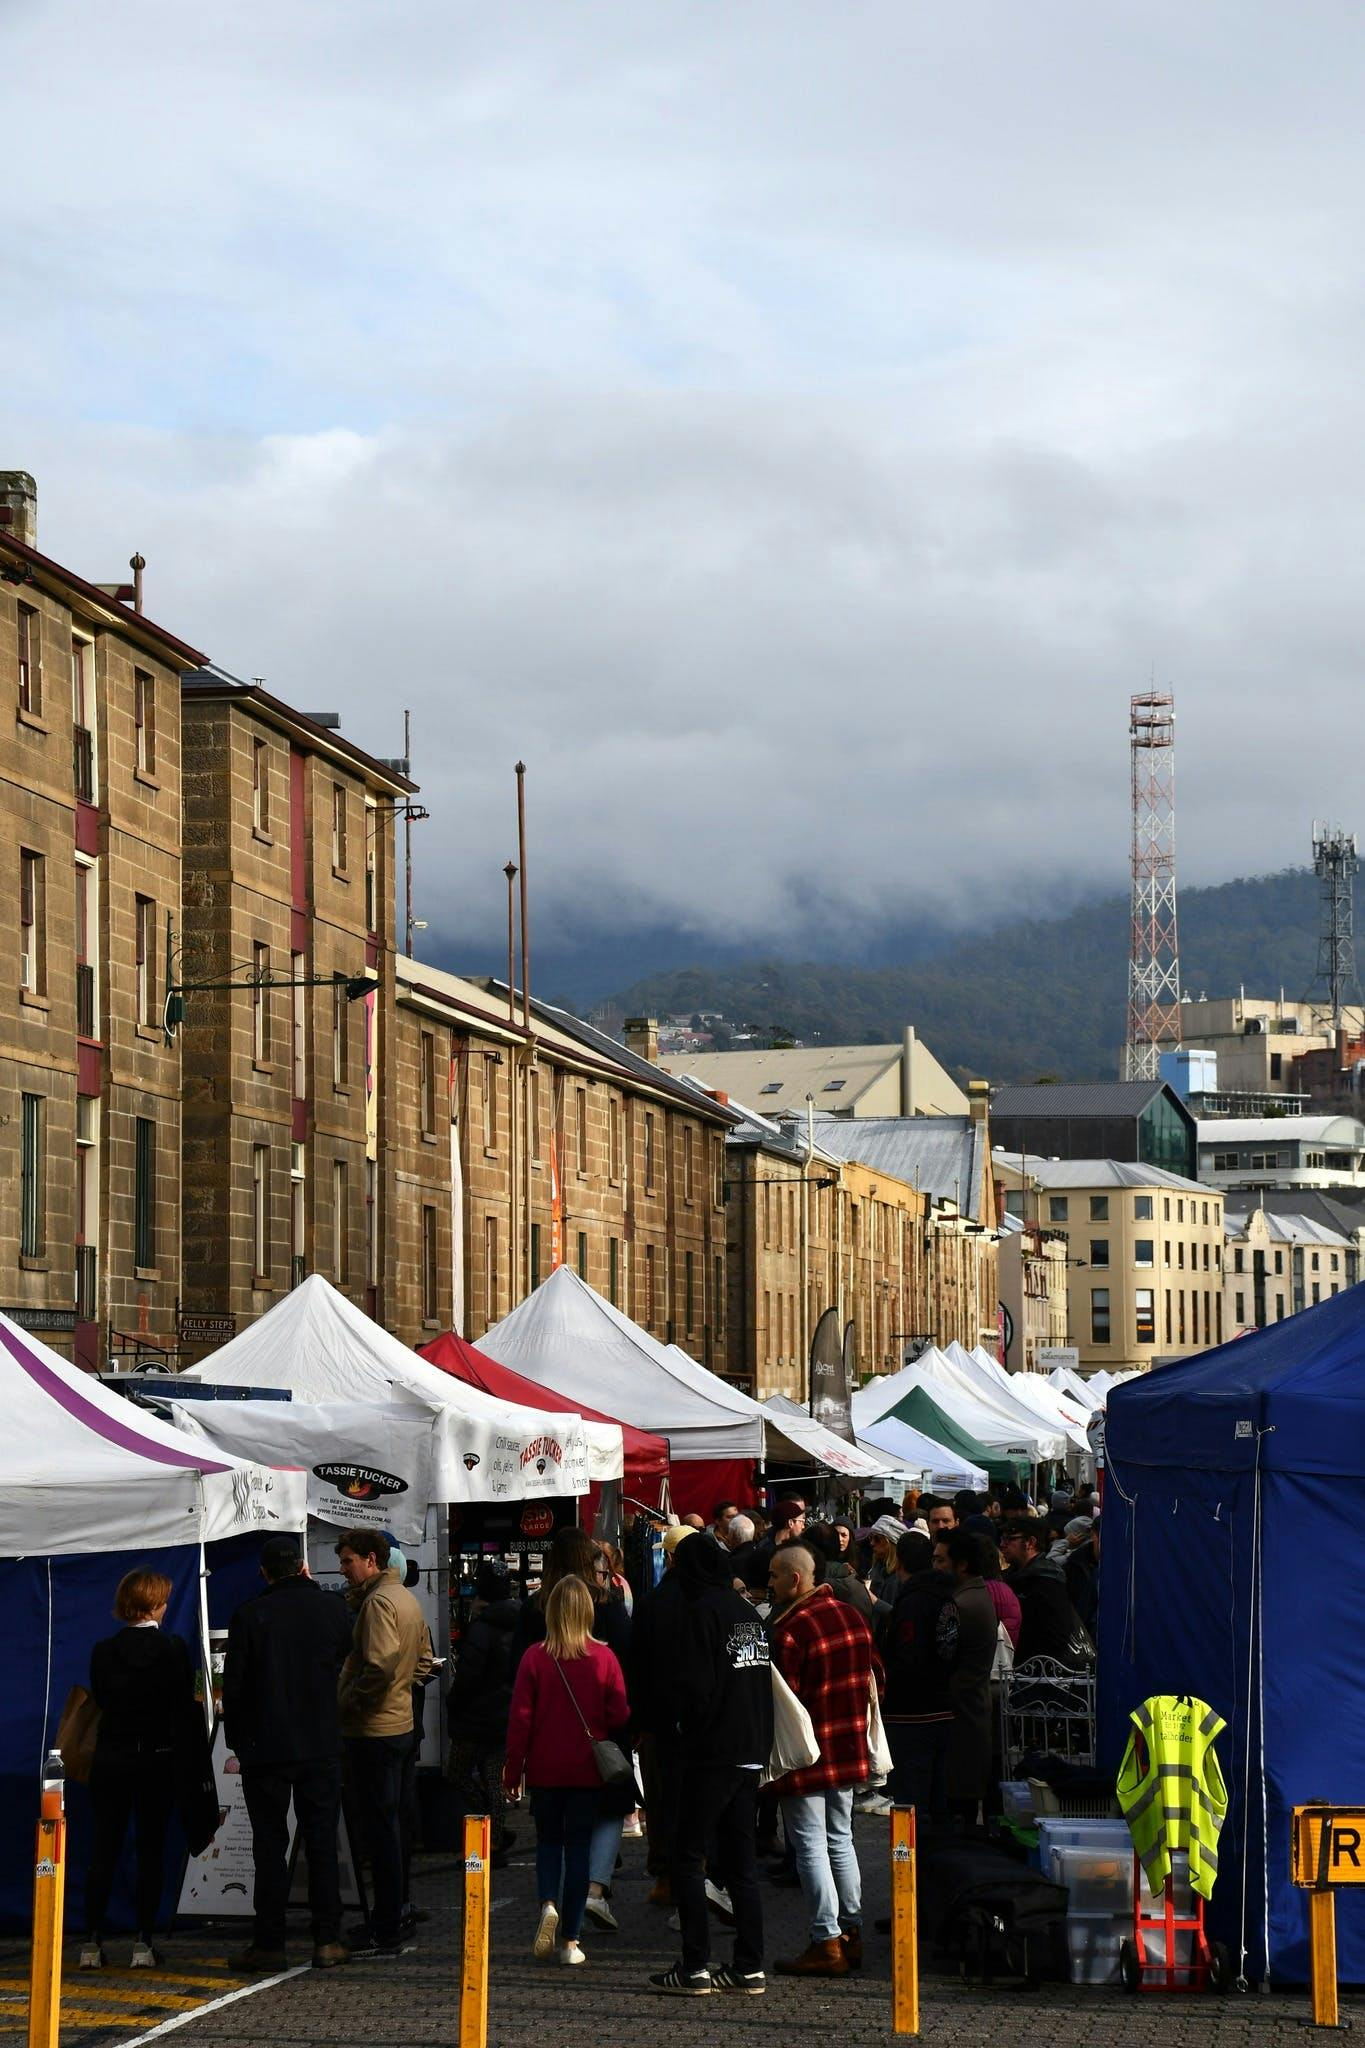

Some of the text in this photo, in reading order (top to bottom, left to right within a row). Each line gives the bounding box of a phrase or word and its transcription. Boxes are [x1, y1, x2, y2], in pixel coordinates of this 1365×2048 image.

[183, 1319, 233, 1330] KELLY STEPS
[520, 1437, 542, 1471] TASSIE
[318, 1466, 401, 1490] TASSIE TUCKER
[338, 1506, 364, 1514] TASMANIA
[360, 1503, 388, 1512] PRODUCTS
[523, 1523, 550, 1531] LARGE
[510, 1542, 526, 1551] RUBS
[527, 1541, 539, 1551] AND
[1160, 1711, 1193, 1723] Market
[1160, 1732, 1193, 1744] tallholder
